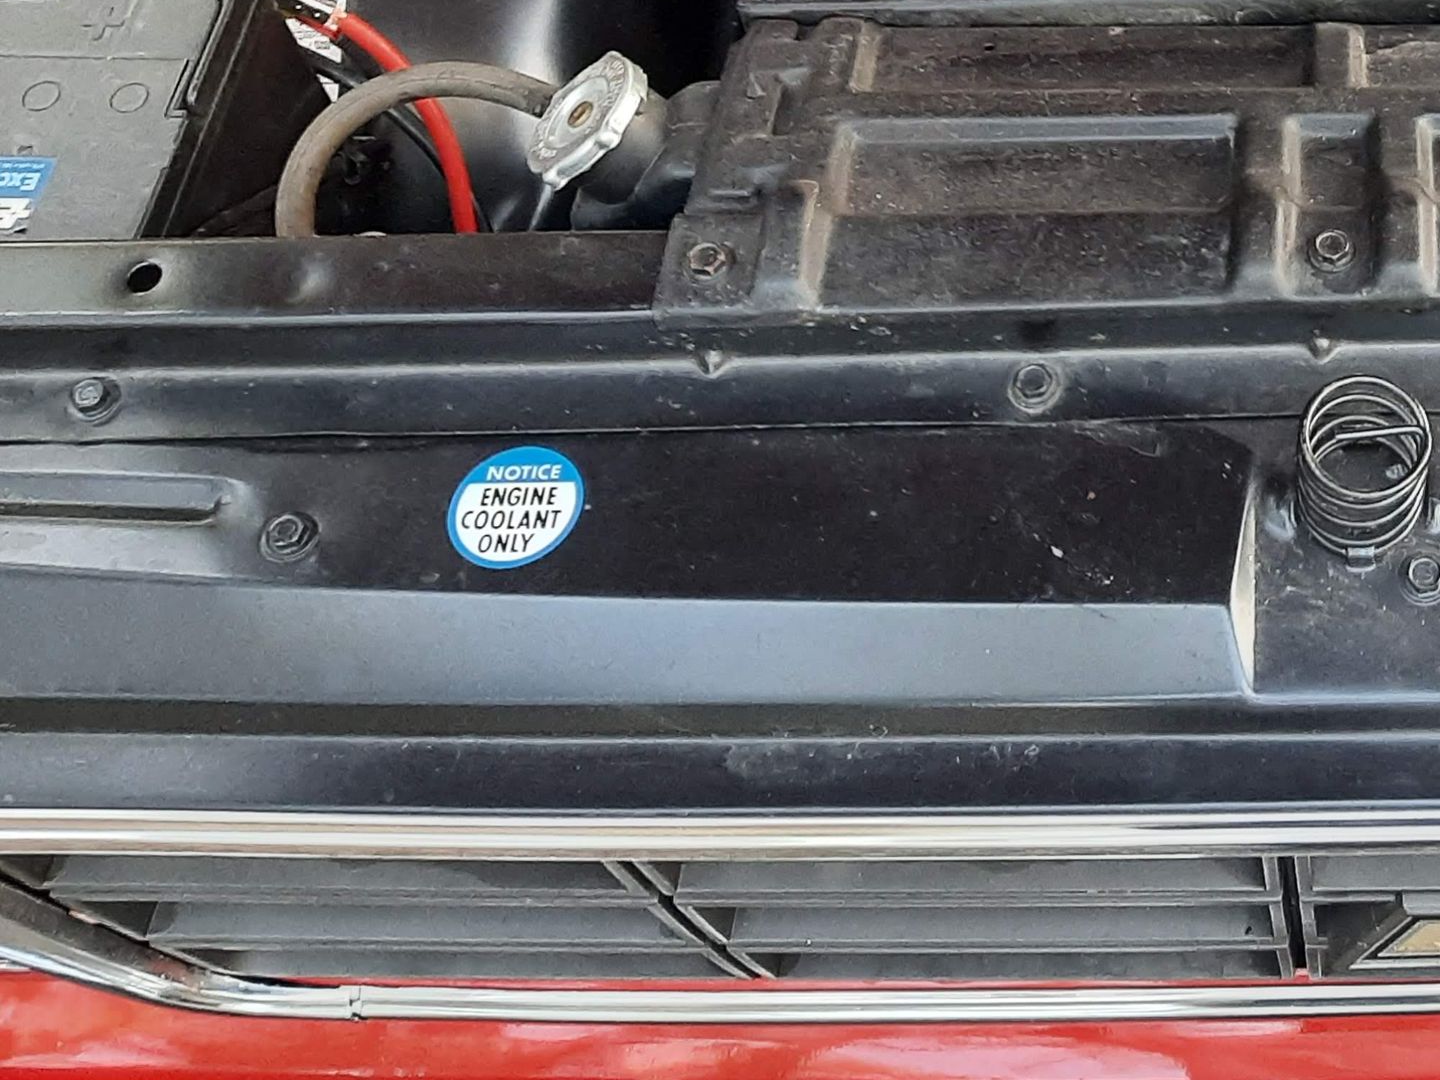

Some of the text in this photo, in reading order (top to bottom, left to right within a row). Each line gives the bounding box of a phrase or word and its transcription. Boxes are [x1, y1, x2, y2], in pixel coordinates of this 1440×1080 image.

[486, 464, 563, 481] NOTICE
[480, 486, 558, 507] ENGINE
[461, 510, 562, 529] COOLANT
[478, 533, 536, 553] ONLY
